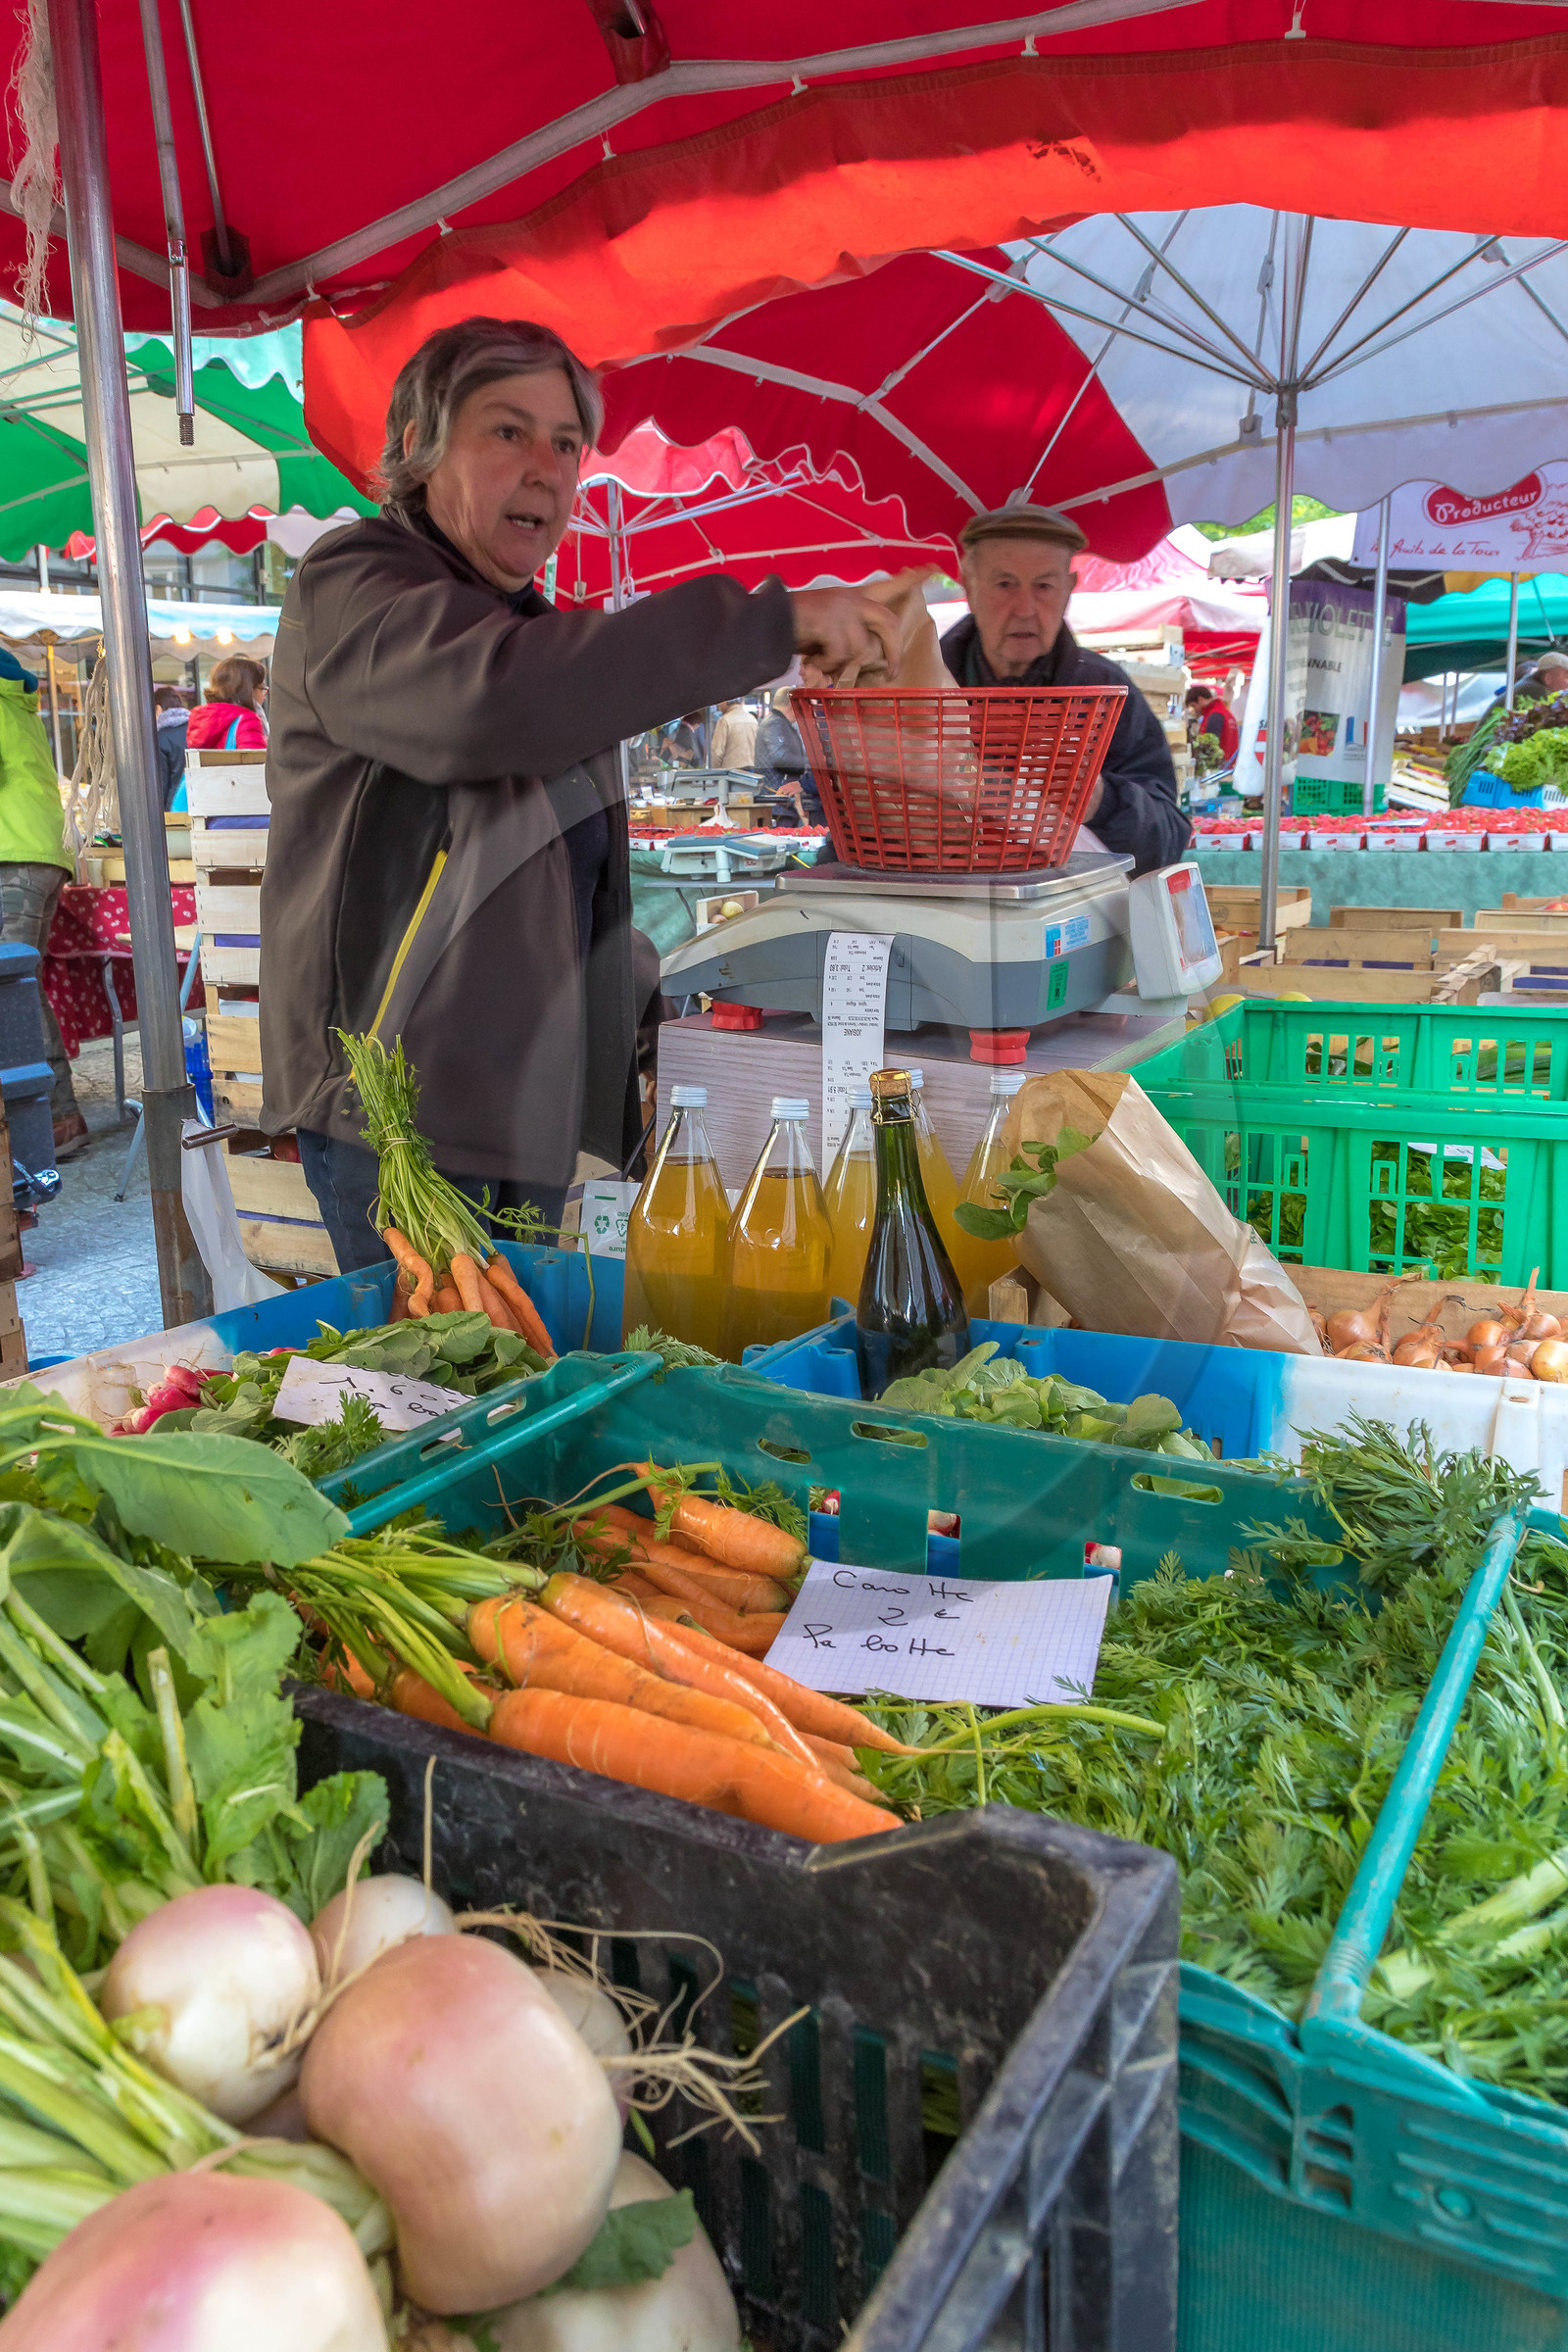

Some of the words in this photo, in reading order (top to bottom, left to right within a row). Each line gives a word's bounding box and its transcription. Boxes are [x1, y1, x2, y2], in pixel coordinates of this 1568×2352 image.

[1435, 491, 1537, 522] Producteur
[1429, 541, 1446, 556] de
[1452, 541, 1465, 556] la
[1468, 541, 1499, 556] Tour
[878, 1608, 908, 1626] 2
